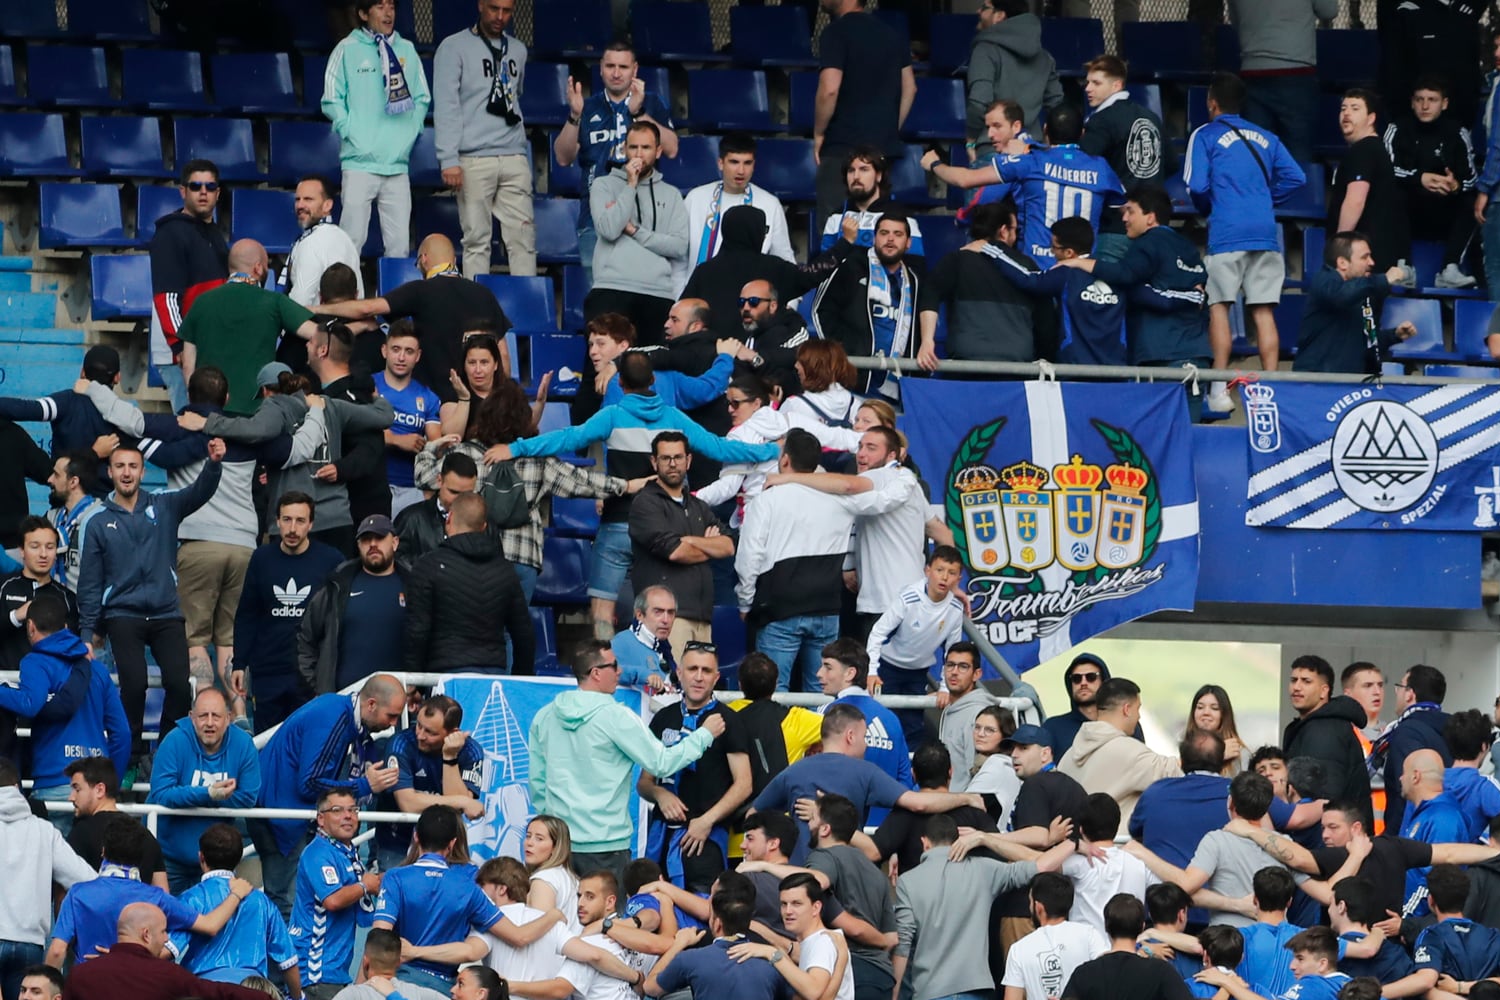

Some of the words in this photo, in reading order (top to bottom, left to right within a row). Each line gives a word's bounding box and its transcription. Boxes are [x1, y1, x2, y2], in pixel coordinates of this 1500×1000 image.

[1045, 161, 1098, 185] VALDERREY
[1044, 180, 1093, 228] 10
[1080, 290, 1117, 304] adidas
[1326, 387, 1374, 422] OVIEDO
[966, 495, 997, 505] OFC
[1400, 482, 1447, 525] SPEZIAL
[271, 606, 304, 617] adida
